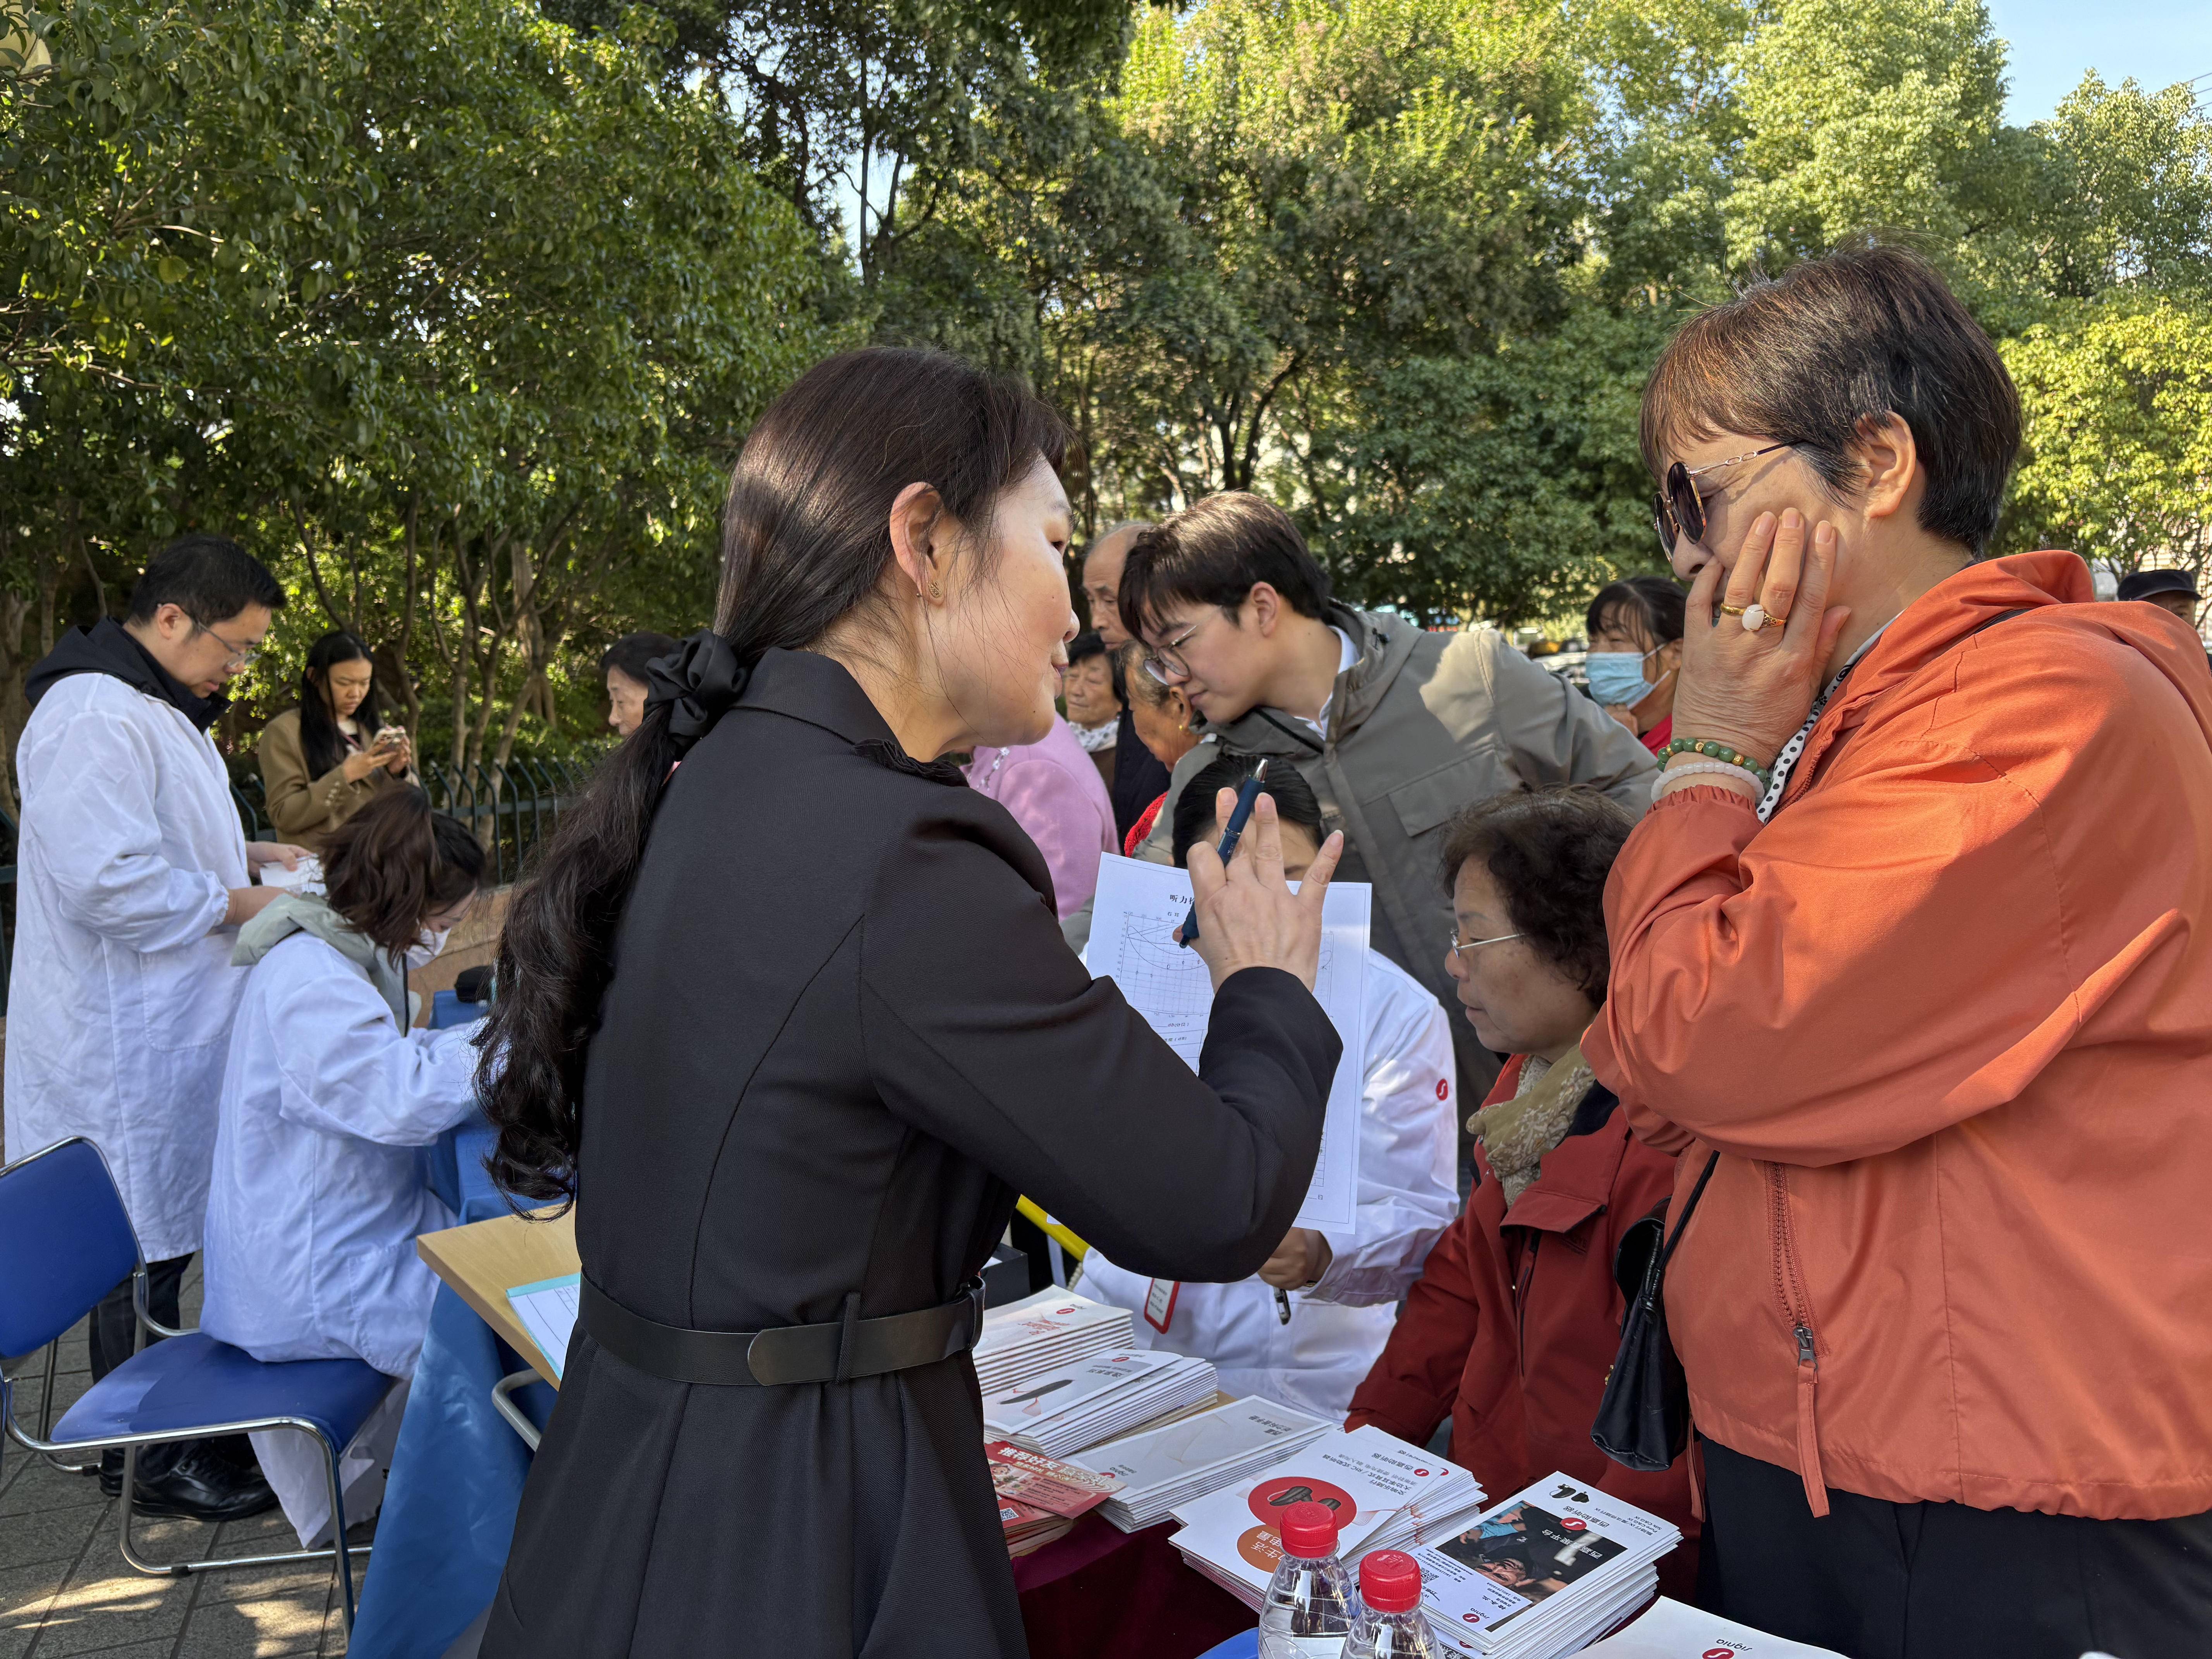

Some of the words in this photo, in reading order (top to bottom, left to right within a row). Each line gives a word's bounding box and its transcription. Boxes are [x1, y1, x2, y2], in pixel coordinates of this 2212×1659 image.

[998, 1447, 1061, 1470] 推荐好友
[1322, 1454, 1351, 1468] 式助听器
[1371, 1453, 1413, 1471] 西嘉助听器
[1367, 1472, 1412, 1491] 大功率耳背式
[1369, 1479, 1407, 1496] 交响乐随行
[1563, 1506, 1609, 1528] 西嘉助听器
[1470, 1607, 1490, 1619] signia
[1716, 1639, 1753, 1651] signia
